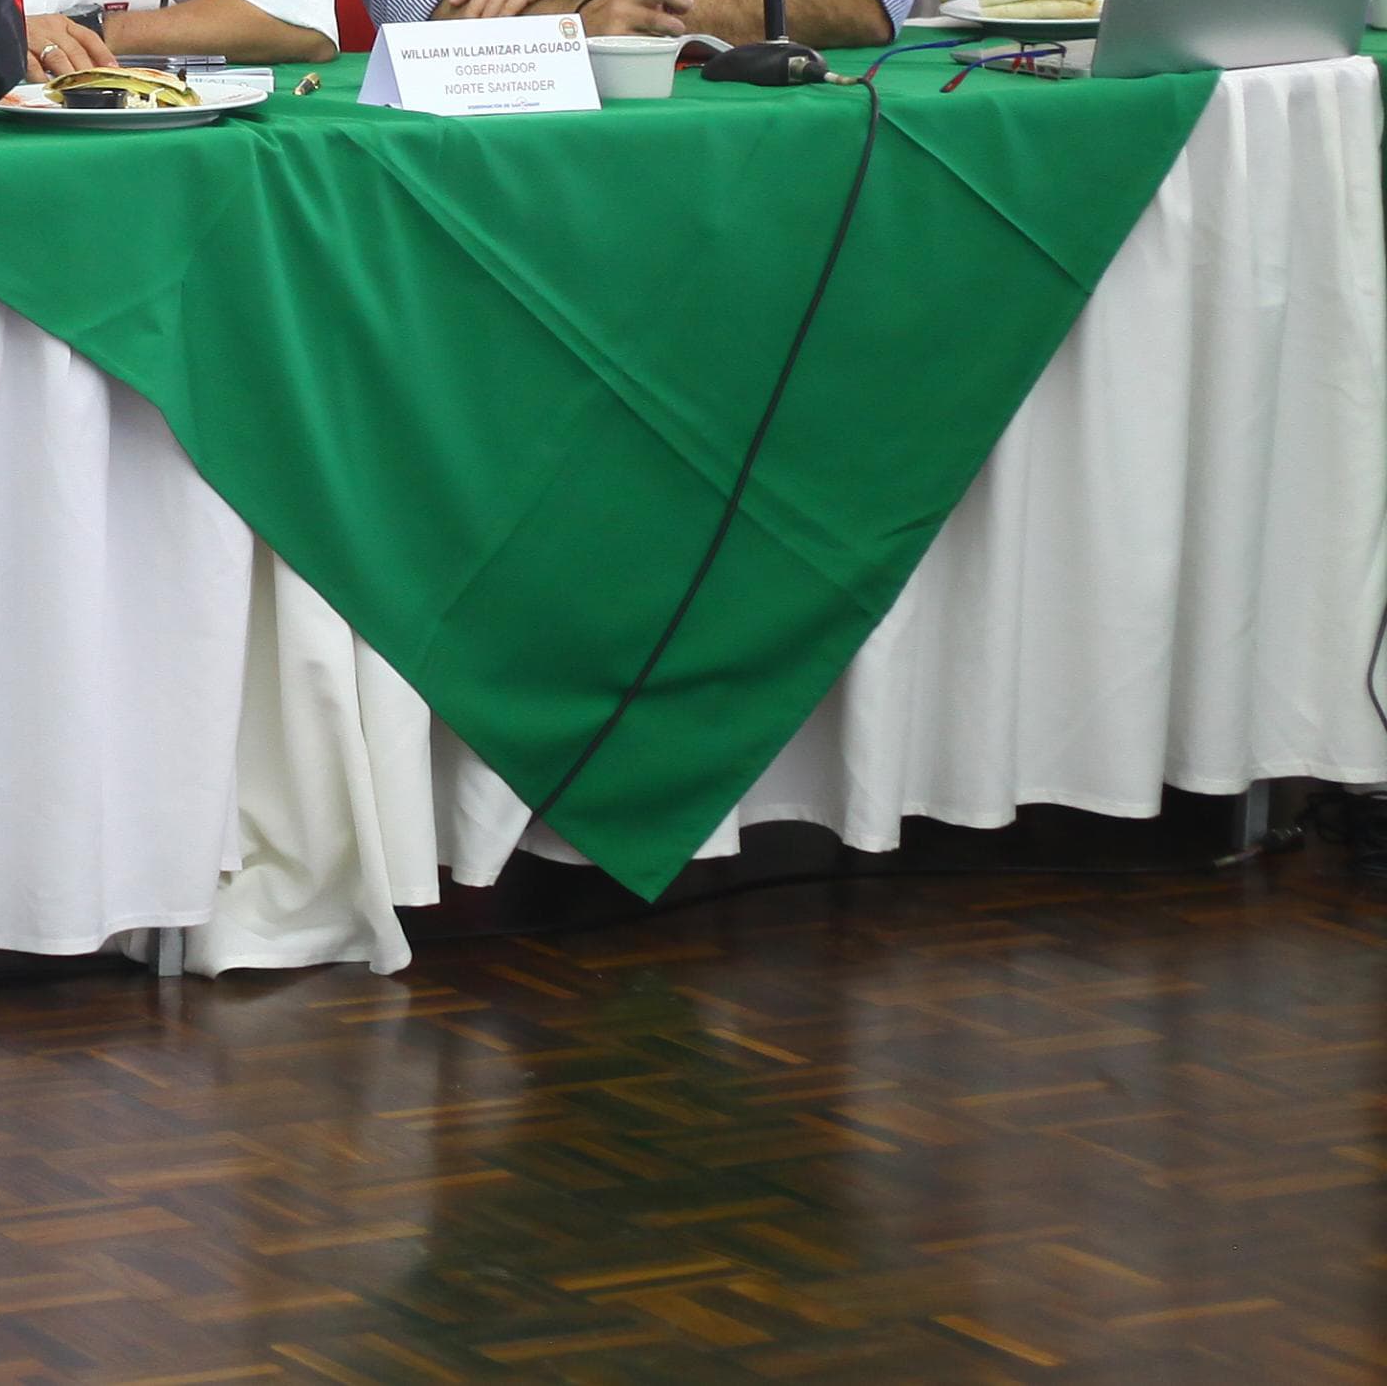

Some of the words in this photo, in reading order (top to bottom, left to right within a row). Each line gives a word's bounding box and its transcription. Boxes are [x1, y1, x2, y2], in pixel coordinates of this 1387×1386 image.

[401, 47, 449, 60] WILLIAM
[452, 44, 521, 58] VILLAMIZAR
[525, 41, 581, 54] LAGUADO
[455, 62, 536, 76] GOBERNADOR
[445, 83, 485, 95] NORTE
[488, 80, 555, 94] SANTANDER
